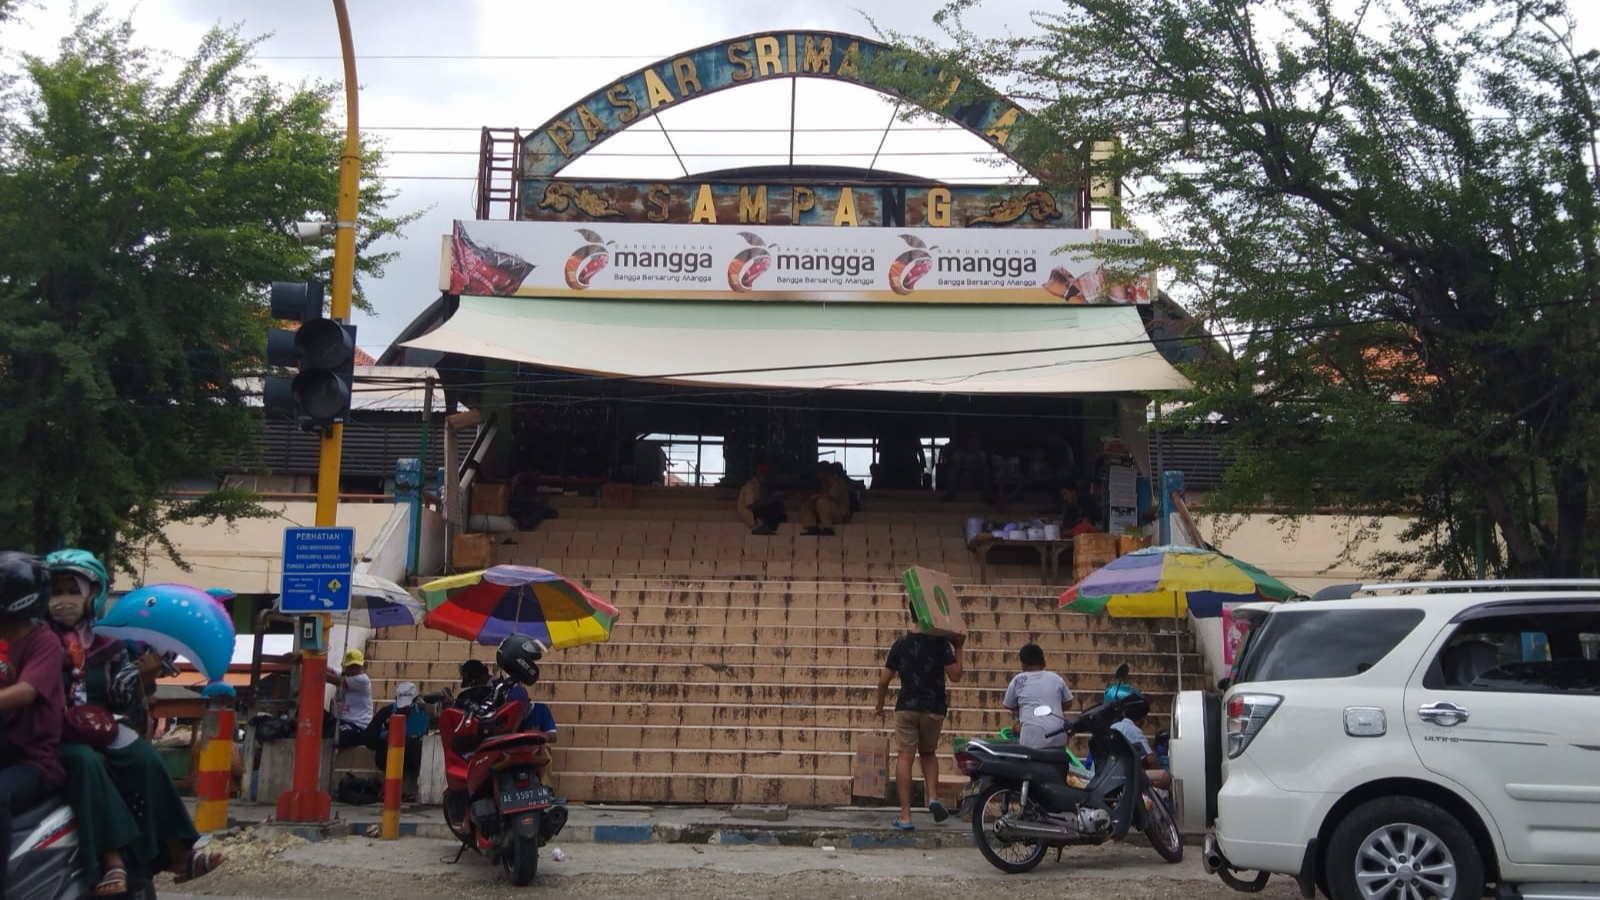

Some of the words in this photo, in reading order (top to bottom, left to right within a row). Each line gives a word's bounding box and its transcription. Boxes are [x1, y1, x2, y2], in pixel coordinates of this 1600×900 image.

[547, 57, 702, 159] PASAR
[649, 183, 951, 228] SAMPANG
[614, 251, 713, 273] mangga
[776, 254, 875, 276] mangga
[938, 256, 1037, 278] mangga
[614, 274, 641, 282] Bangga
[642, 274, 680, 283] Bersarung
[682, 275, 712, 283] Mangga
[776, 276, 803, 284] Bangga
[804, 276, 843, 285] Bersarung
[844, 277, 874, 285] Mangga
[938, 278, 965, 286] Bangga
[966, 278, 1005, 287] Bersarung
[1006, 279, 1037, 287] Mangga
[503, 794, 513, 802] AE
[515, 790, 533, 800] 5597
